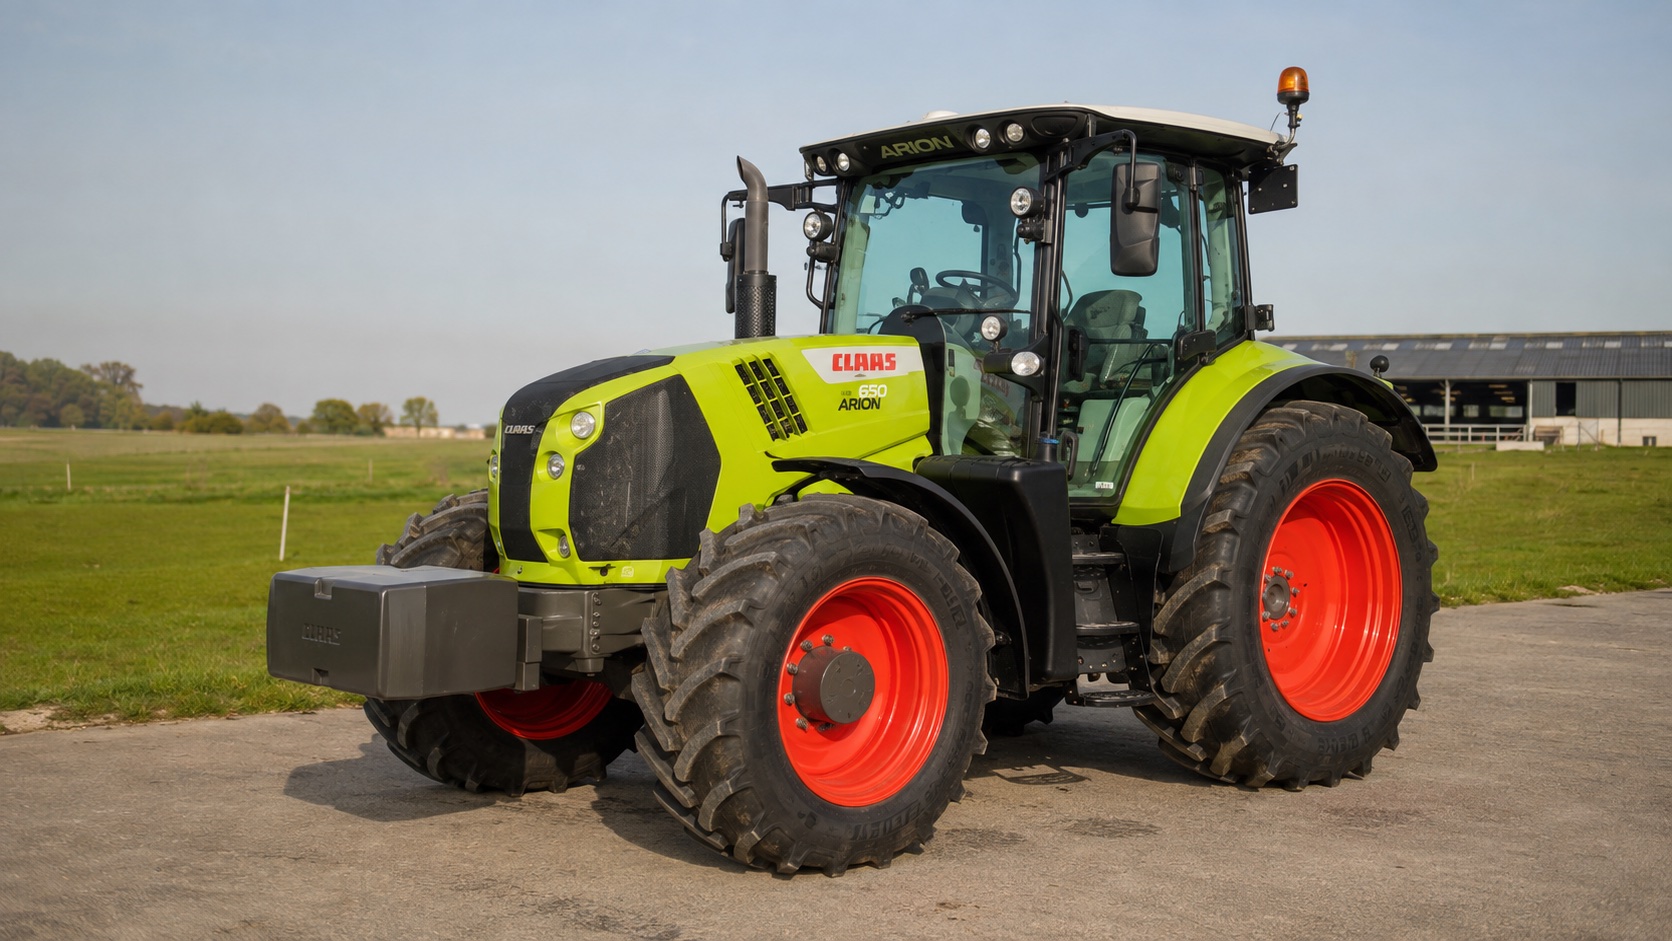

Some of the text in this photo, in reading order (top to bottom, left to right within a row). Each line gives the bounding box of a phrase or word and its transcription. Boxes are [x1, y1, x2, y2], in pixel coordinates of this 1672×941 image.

[881, 135, 955, 159] ARION
[832, 353, 897, 372] CLAAS
[858, 384, 888, 398] 650
[838, 397, 881, 411] ARION
